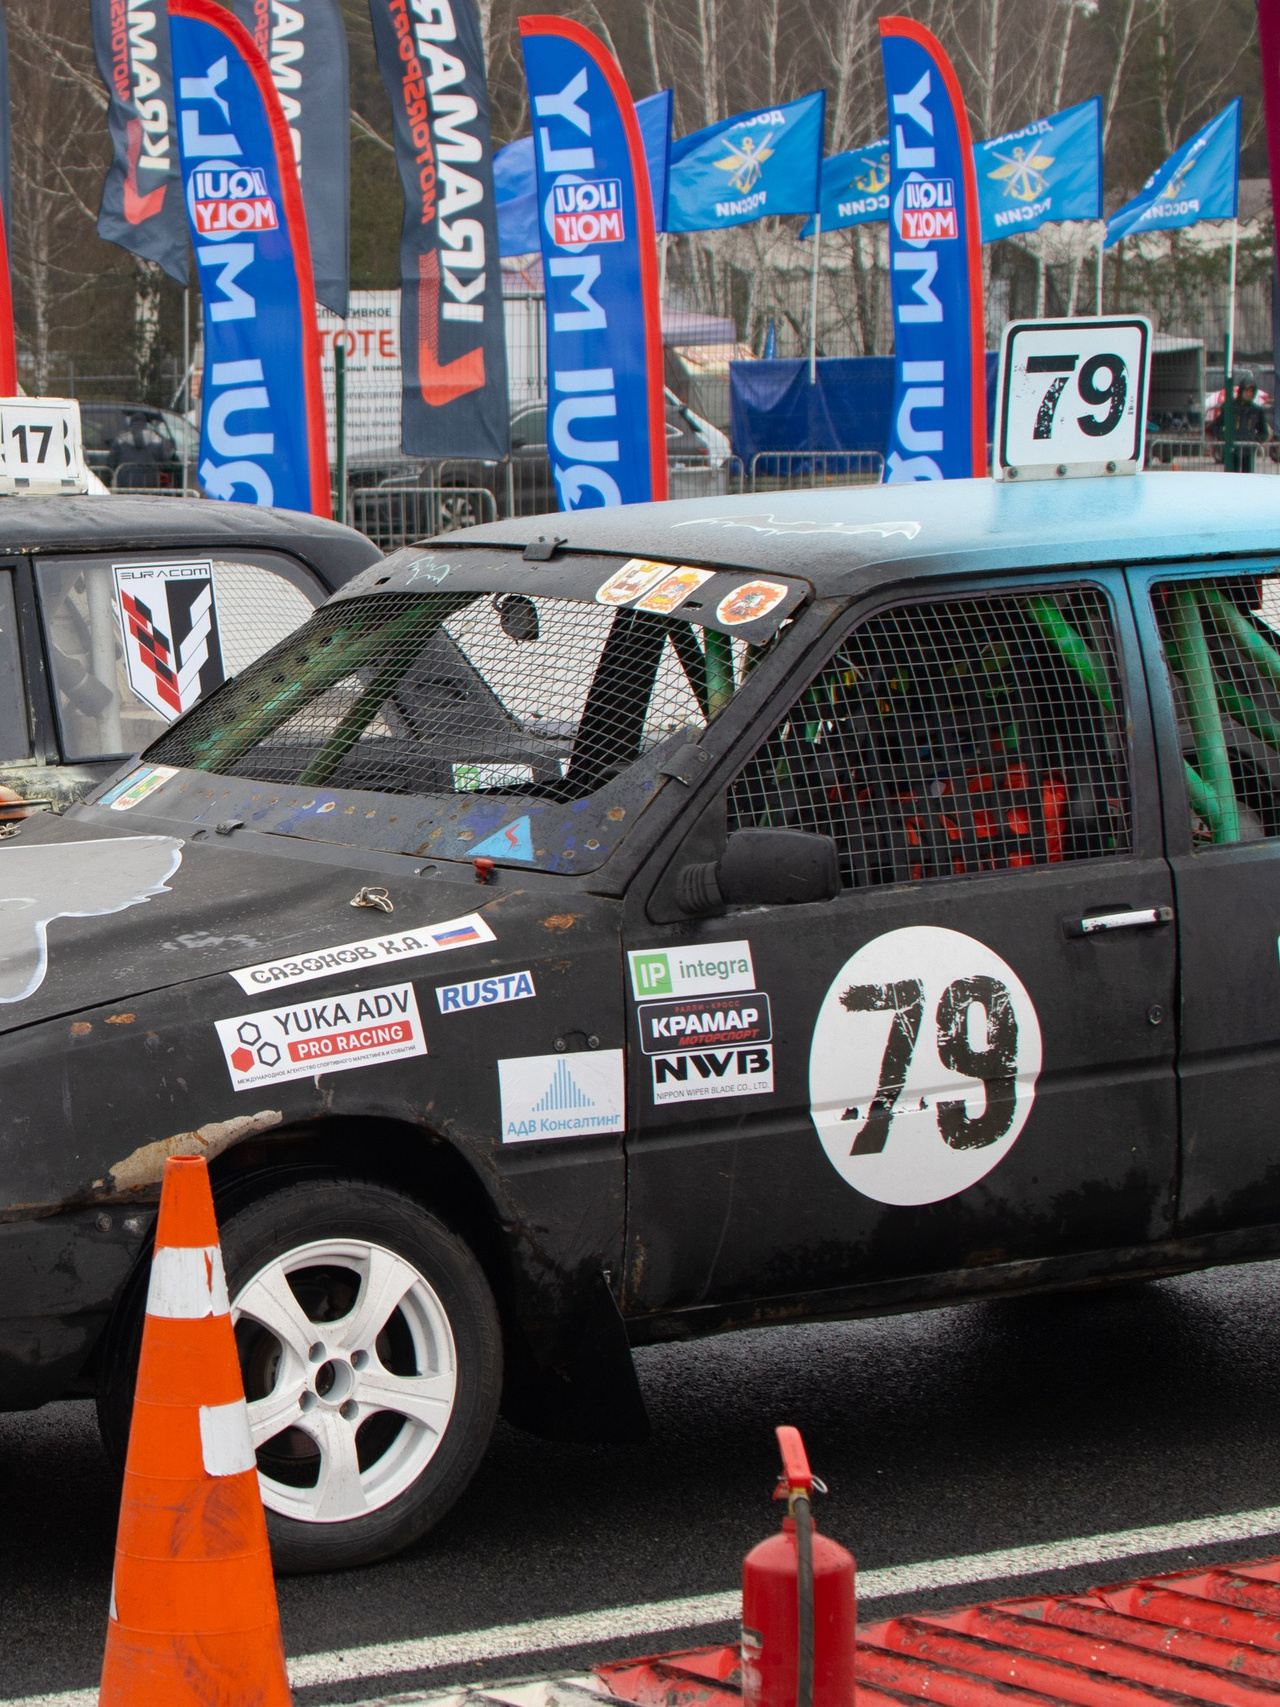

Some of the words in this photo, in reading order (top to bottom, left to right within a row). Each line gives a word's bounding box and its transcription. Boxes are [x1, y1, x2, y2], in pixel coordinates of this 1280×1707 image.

[316, 307, 392, 319] СПОТИВНОЕ
[317, 329, 397, 359] ТОТЕ
[1026, 352, 1127, 441] 79
[12, 424, 53, 464] 17
[120, 567, 209, 581] EURACOM
[250, 945, 377, 985] САЗОНОВ
[380, 935, 429, 960] К.А.
[640, 962, 667, 988] IP
[678, 957, 750, 980] integra
[441, 973, 535, 1011] RUSTA
[273, 1002, 351, 1036] YUKA
[356, 989, 409, 1022] ADV
[651, 1008, 759, 1038] КРАМАР
[298, 1038, 337, 1059] PRO
[336, 1025, 404, 1051] RACING
[678, 1029, 760, 1046] МОТОРСПОРТ
[237, 1070, 287, 1085] МЕЖДУНАРОДНОЕ
[286, 1064, 317, 1076] АГЕНТСТВО
[316, 1057, 353, 1070] СПОРТИВНОГО
[352, 1051, 386, 1063] МАРКЕТИНГА
[390, 1044, 417, 1056] СОБЫТИЙ
[654, 1048, 771, 1084] NWB
[838, 975, 1019, 1157] 79
[656, 1089, 685, 1100] NIPPON
[686, 1087, 709, 1096] WIPER
[711, 1084, 735, 1094] BLADE
[754, 1081, 770, 1090] LTD.
[507, 1118, 537, 1137] АДВ
[540, 1112, 622, 1134] Консалтинг
